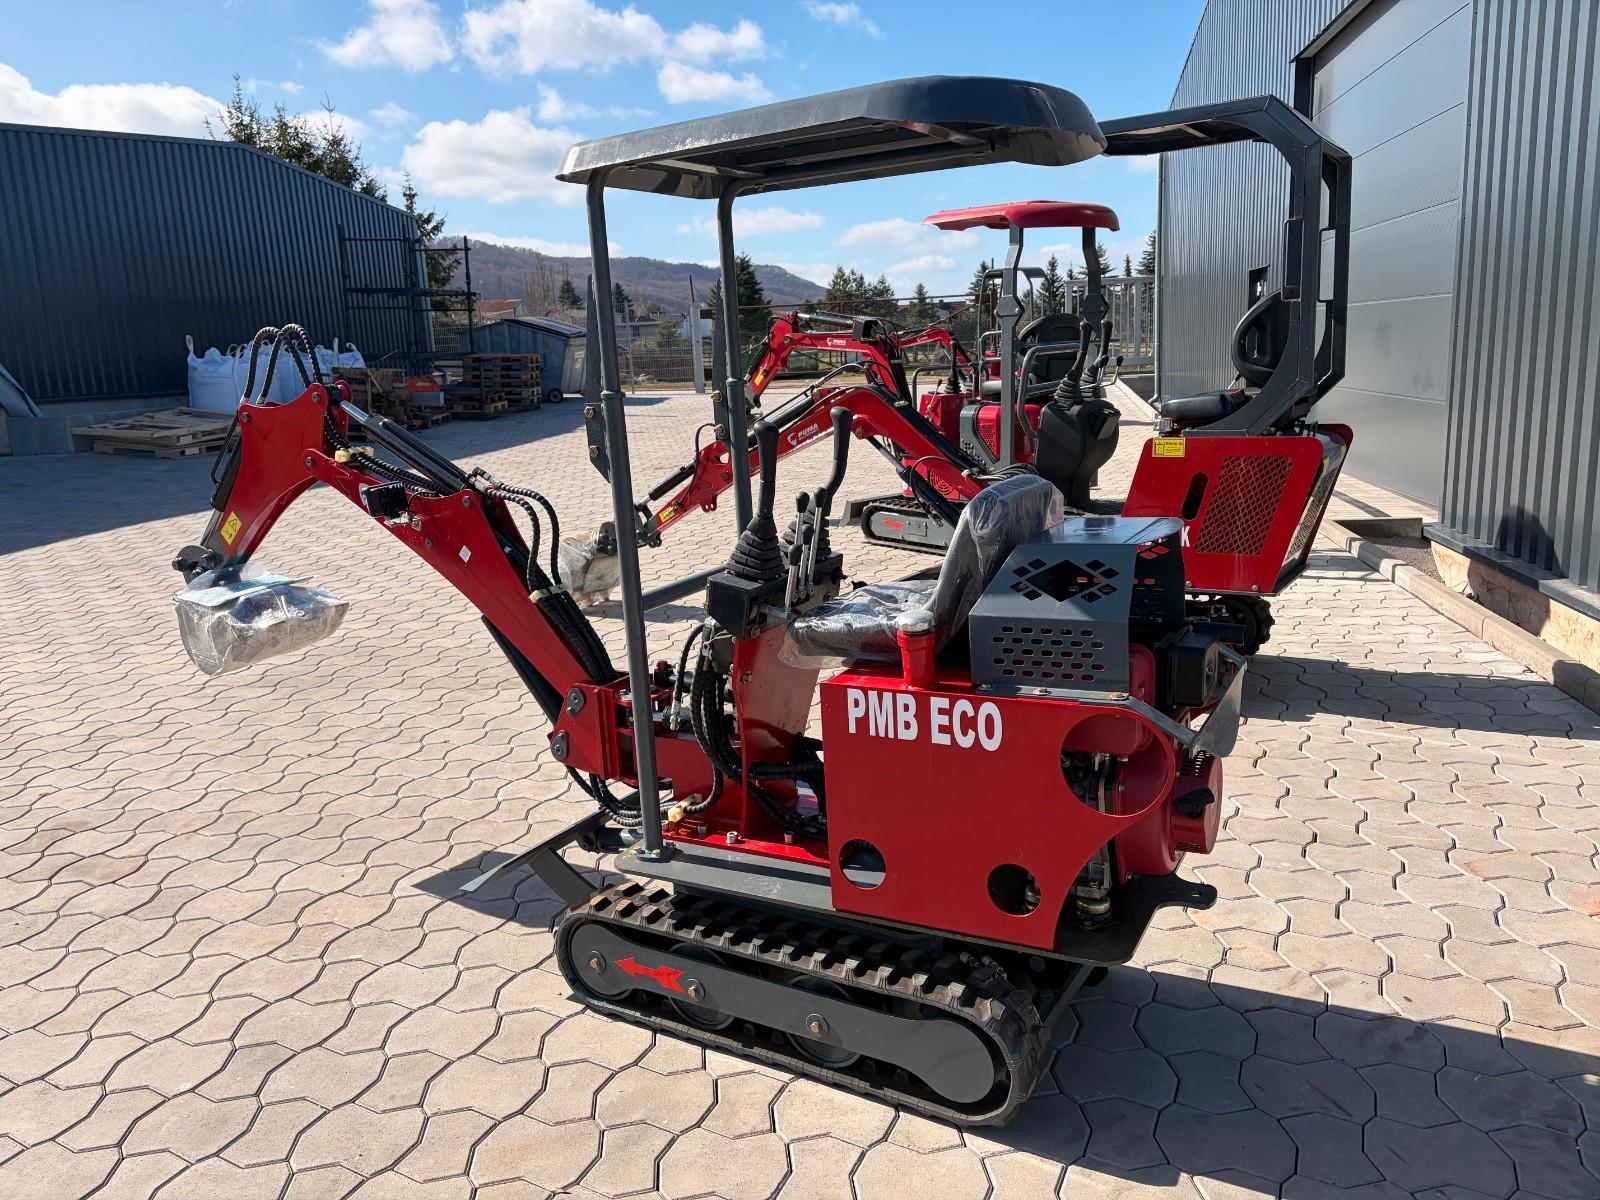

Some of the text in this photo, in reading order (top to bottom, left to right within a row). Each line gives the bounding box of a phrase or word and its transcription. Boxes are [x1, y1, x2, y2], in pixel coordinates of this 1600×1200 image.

[798, 423, 819, 437] PUMA
[847, 688, 1002, 751] PMB ECO
